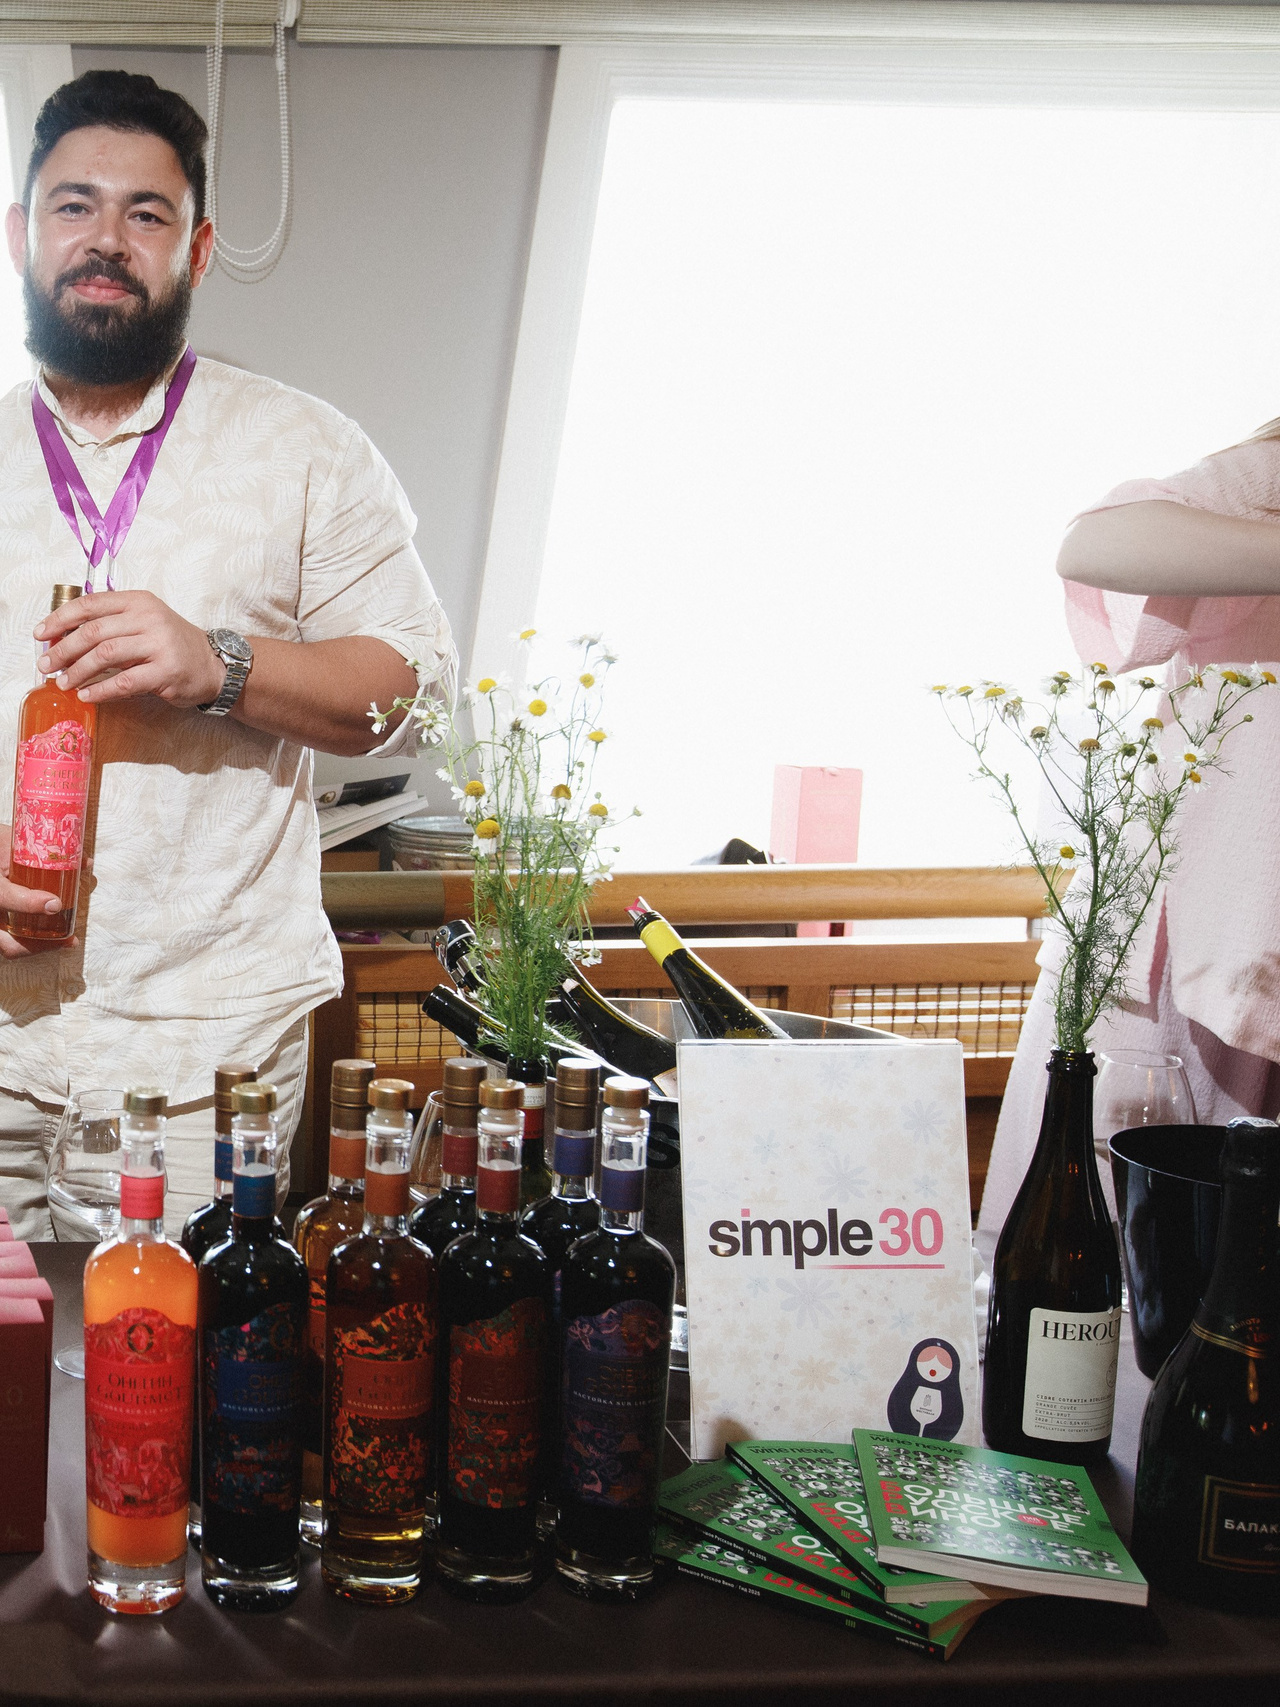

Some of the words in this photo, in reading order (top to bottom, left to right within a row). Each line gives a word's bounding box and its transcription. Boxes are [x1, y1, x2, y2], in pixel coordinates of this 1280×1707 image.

[1041, 1318, 1120, 1342] HEROU
[748, 1446, 789, 1454] wine
[869, 1434, 912, 1446] wine
[915, 1442, 964, 1456] news
[879, 1480, 1085, 1527] БОЛЬШОЕ
[885, 1501, 1001, 1529] ВИНО
[1224, 1517, 1280, 1535] БАЛАК
